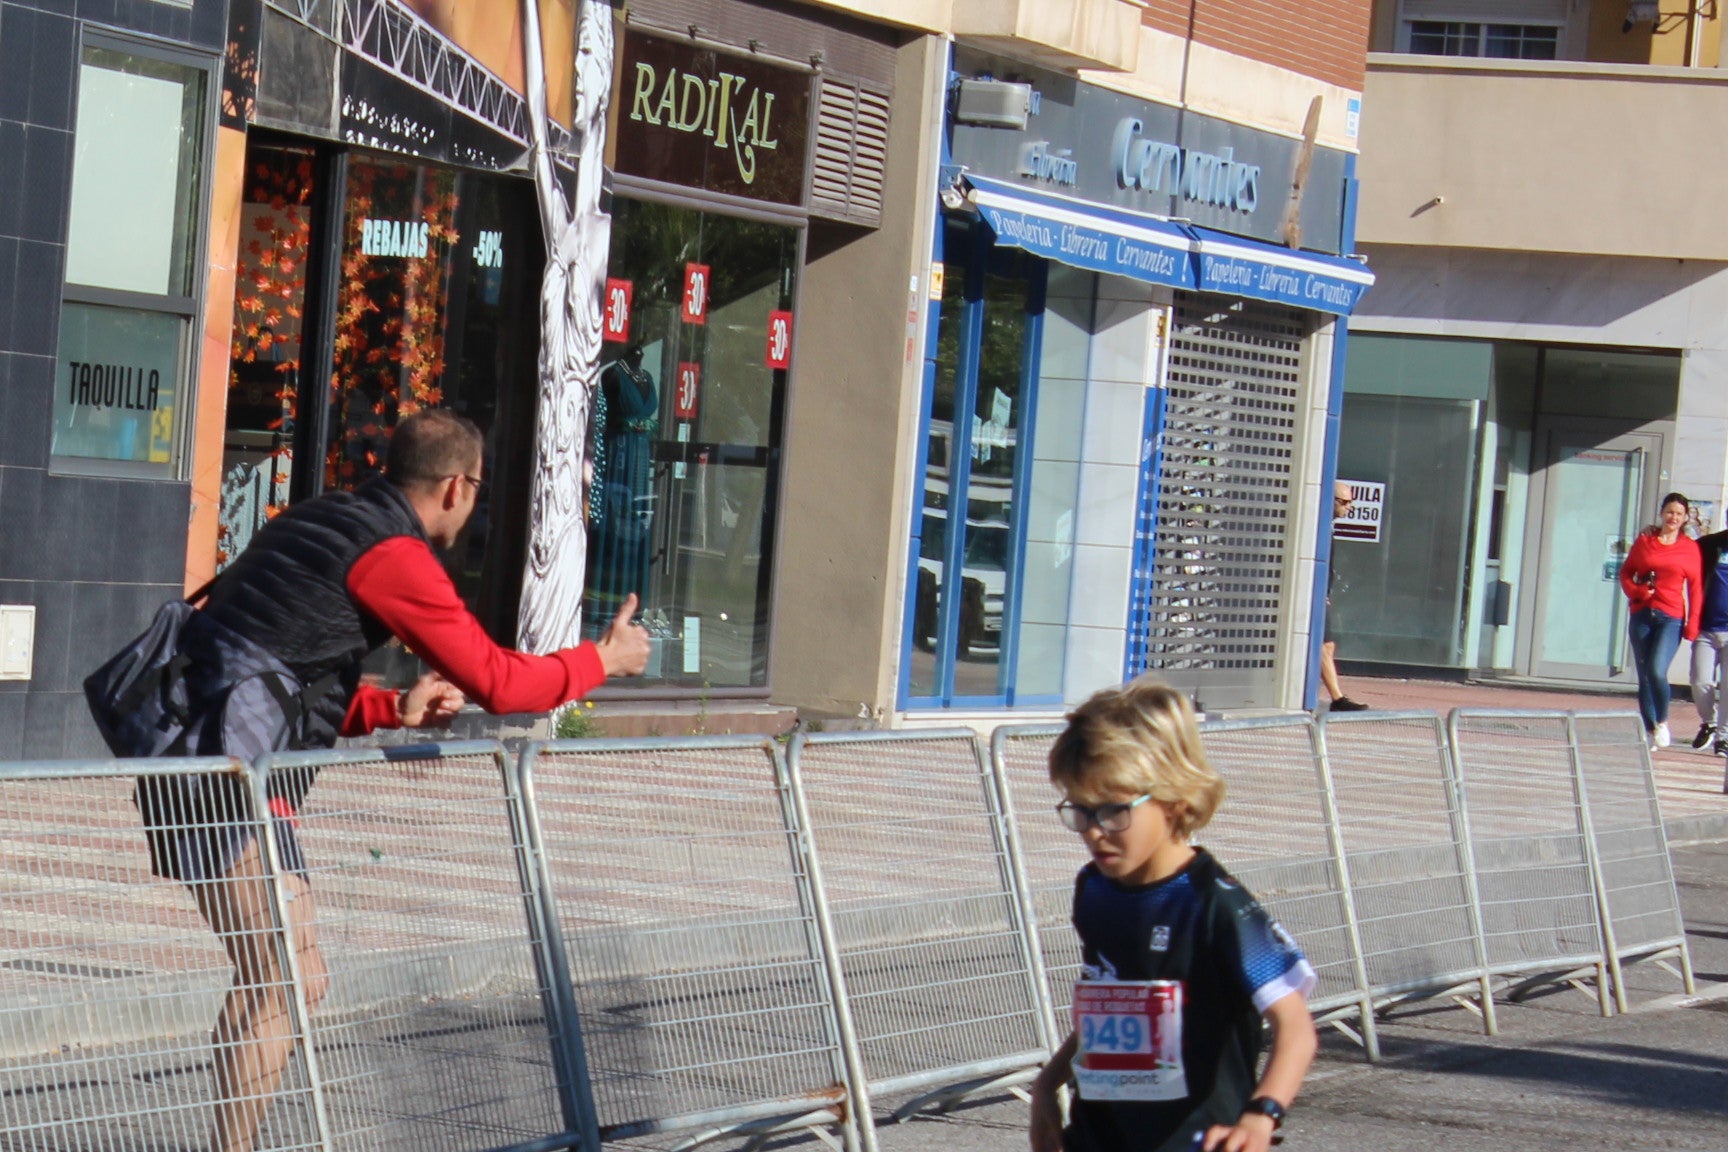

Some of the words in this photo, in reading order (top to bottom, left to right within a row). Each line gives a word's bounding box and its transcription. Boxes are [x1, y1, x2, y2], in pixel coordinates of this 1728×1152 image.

[629, 61, 778, 184] RADIKAL
[362, 218, 429, 258] REBAJAS
[473, 230, 503, 268] -50%
[1116, 236, 1176, 277] Cervantes
[1305, 273, 1354, 307] Cervantes
[70, 361, 160, 411] TAQUILLA
[1347, 505, 1379, 521] 8150
[1351, 485, 1380, 502] UILA
